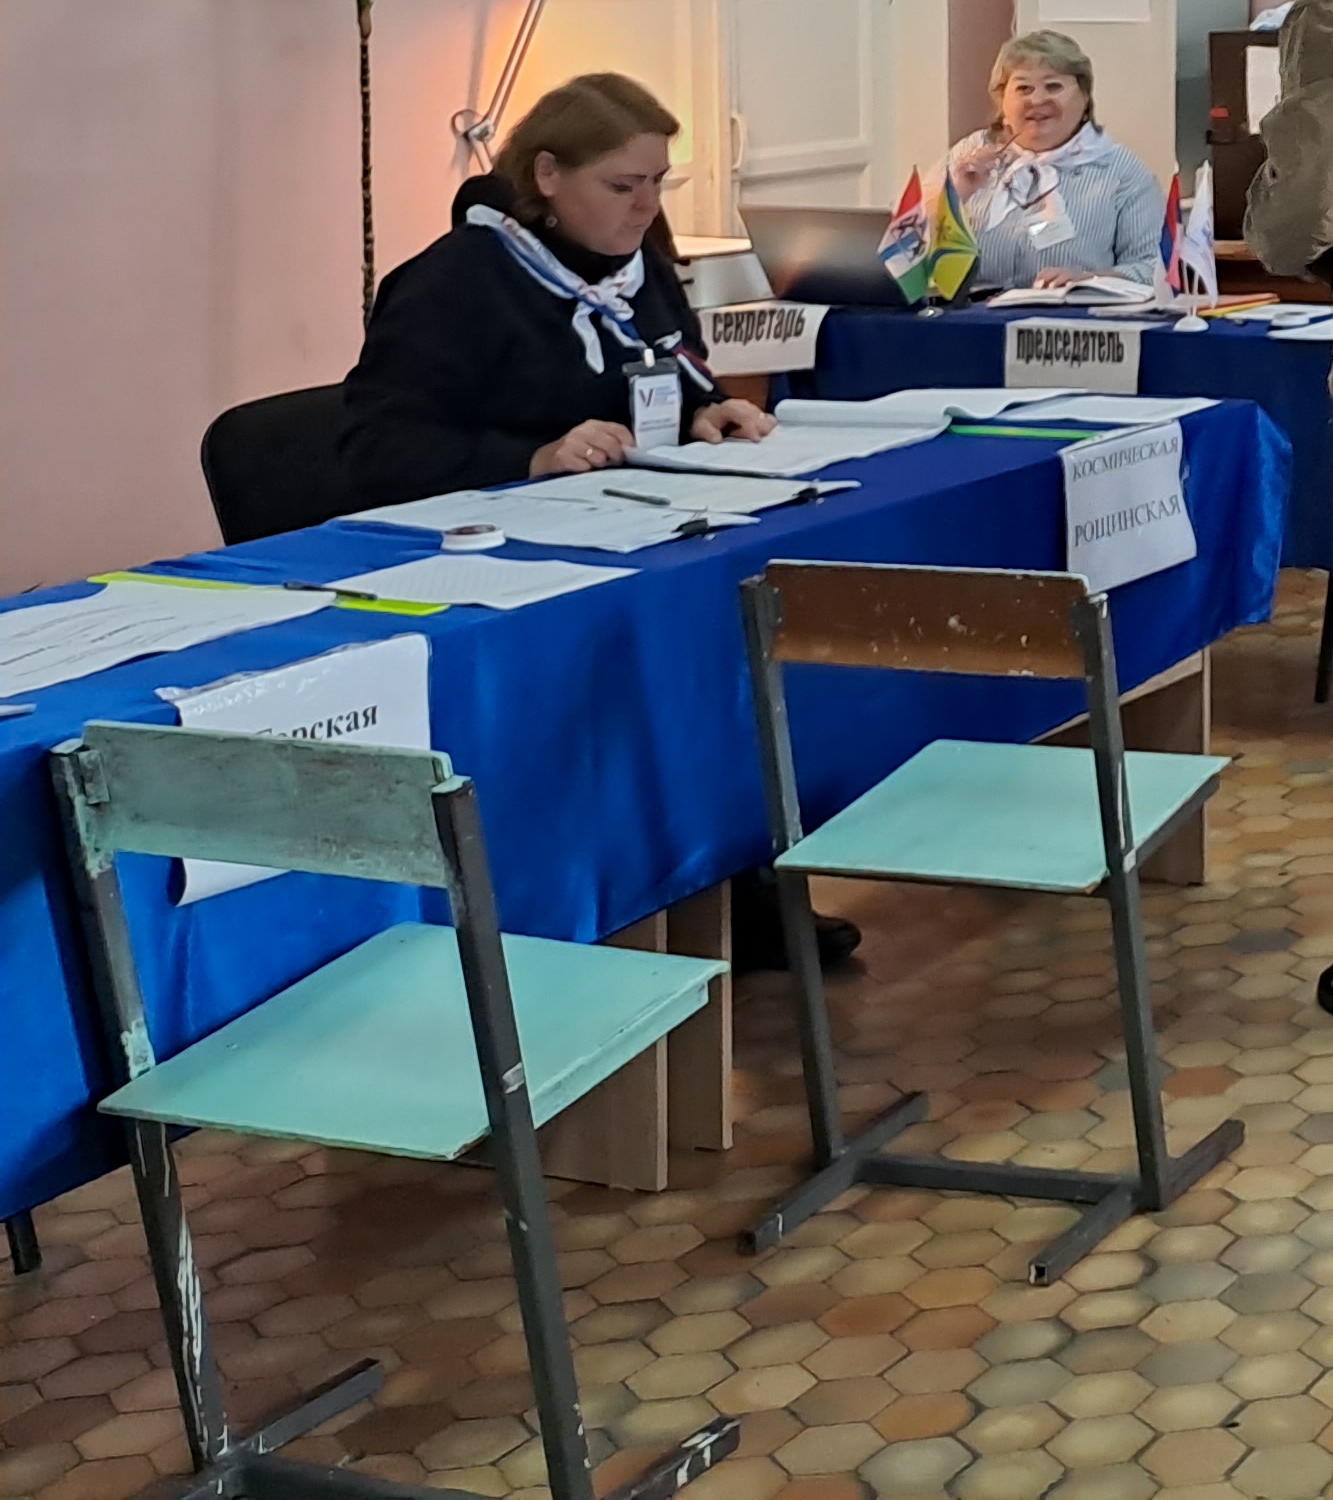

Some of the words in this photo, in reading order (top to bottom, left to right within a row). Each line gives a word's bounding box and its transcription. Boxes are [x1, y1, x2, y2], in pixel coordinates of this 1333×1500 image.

[711, 307, 807, 347] секретарь
[1016, 327, 1125, 369] председатель
[1072, 435, 1179, 481] КОСМИЧЕСКАЯ
[1074, 493, 1182, 548] РОЩИНСКАЯ
[255, 704, 379, 741] ская
